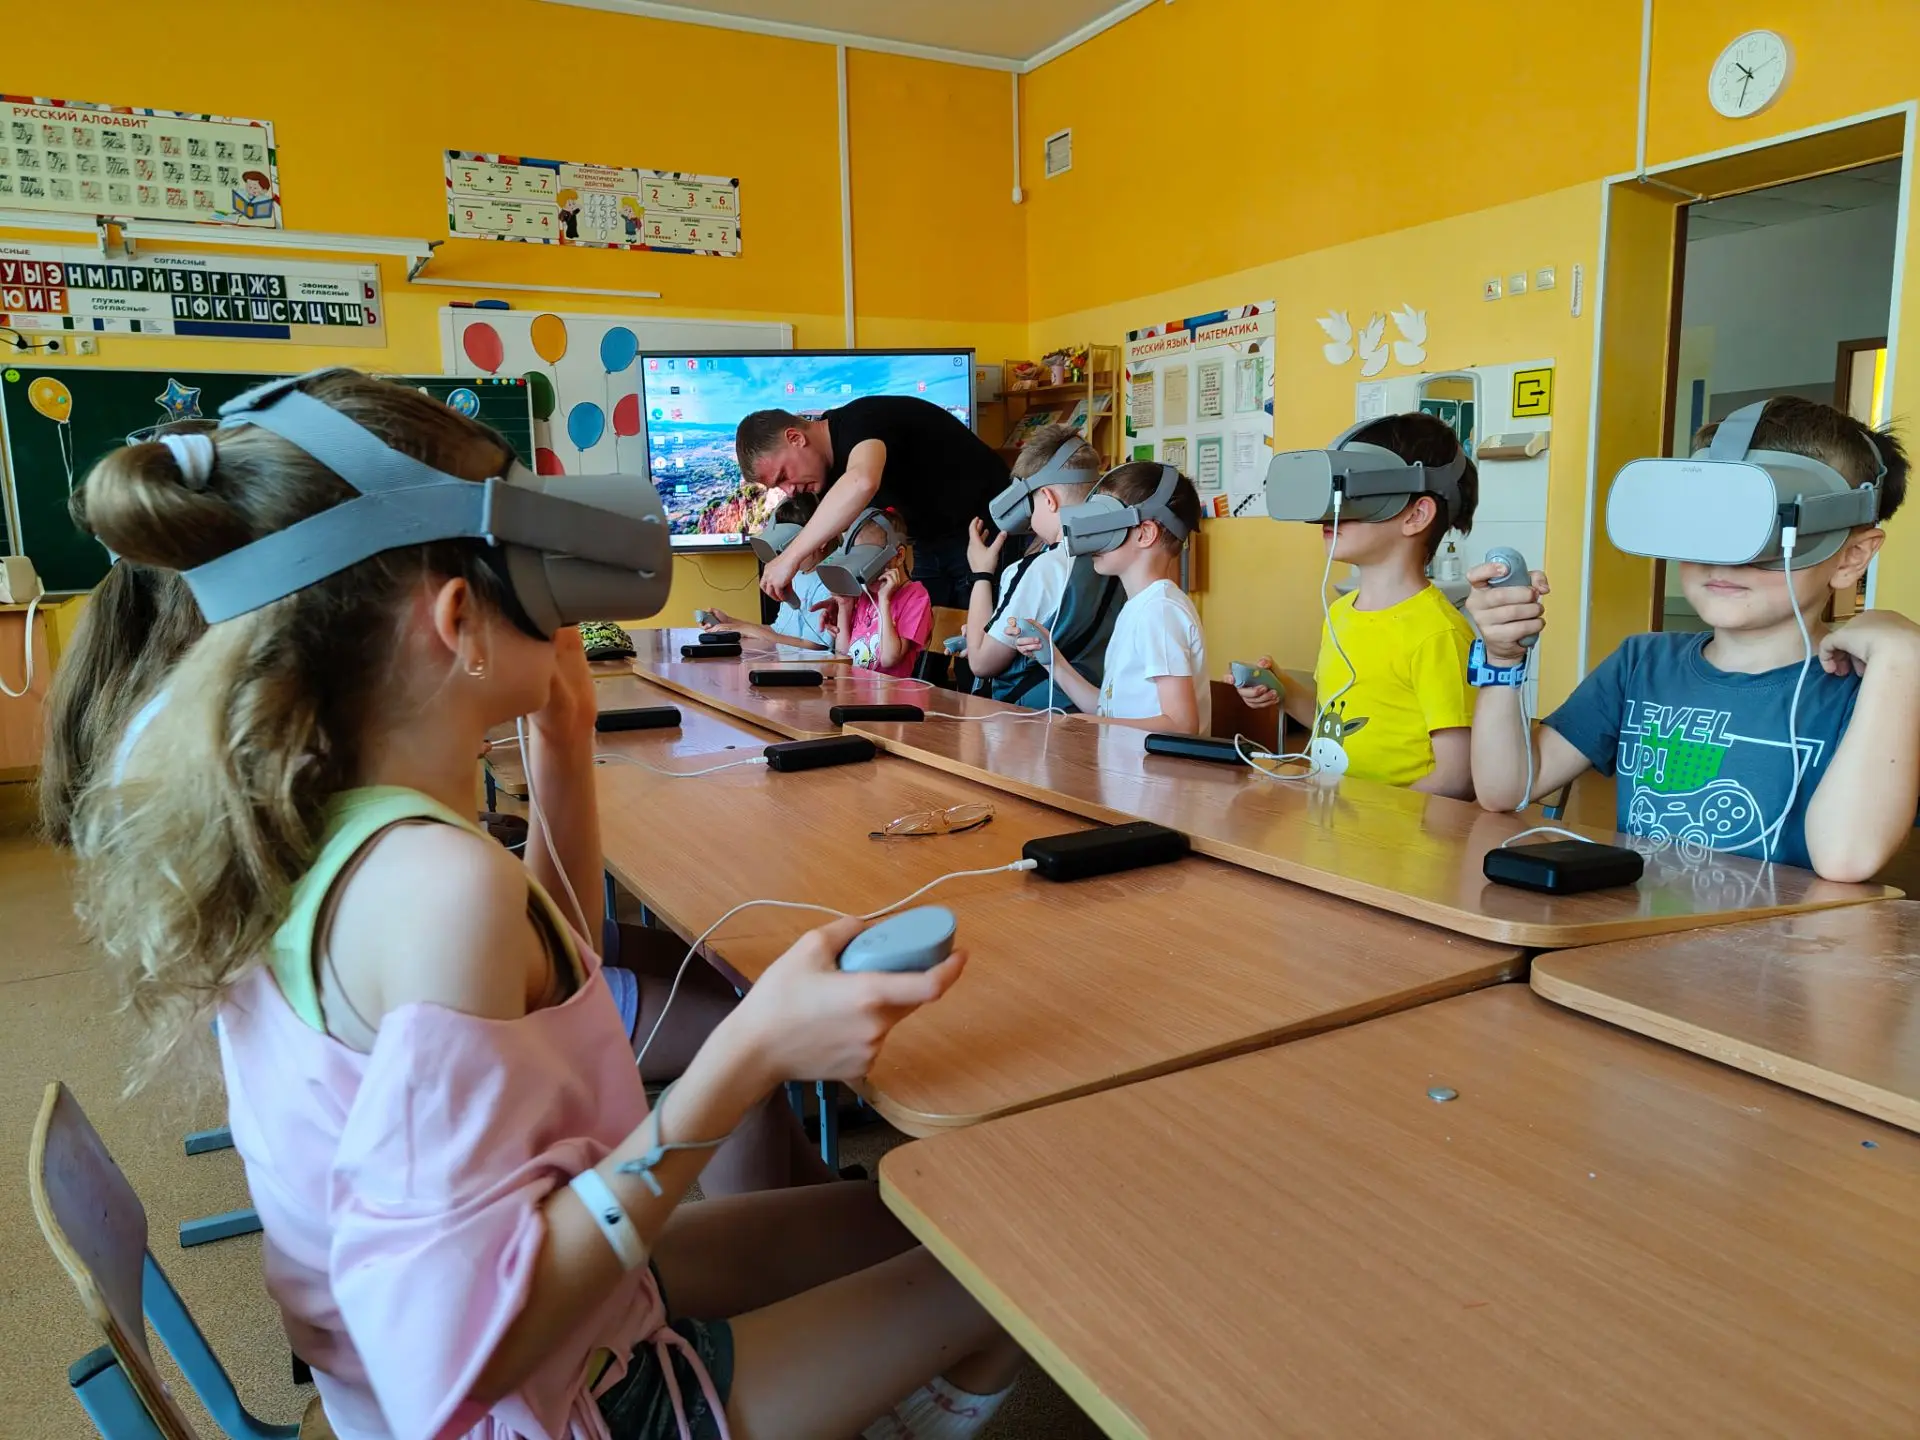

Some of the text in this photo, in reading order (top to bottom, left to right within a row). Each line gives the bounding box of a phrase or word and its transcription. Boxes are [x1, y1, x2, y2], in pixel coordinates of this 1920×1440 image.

[13, 107, 149, 129] РУССКИЙ АЛФАВИТ
[464, 171, 472, 182] 5
[504, 176, 512, 187] 2
[540, 179, 547, 189] 7
[610, 195, 617, 207] 3
[652, 189, 659, 200] 2
[688, 192, 695, 203] 3
[719, 195, 726, 206] 6
[465, 210, 473, 221] 9
[506, 213, 514, 224] 5
[541, 216, 549, 226] 4
[654, 225, 661, 235] 8
[689, 228, 697, 238] 4
[721, 231, 727, 241] 2
[154, 257, 207, 267] СОГЛАСНЫЕ
[1198, 321, 1259, 343] МАТЕМАТИКА
[1131, 336, 1189, 357] РУССКИЙ ЯЗЫК
[1620, 699, 1734, 748] LEVEL
[1616, 741, 1668, 784] UP!
